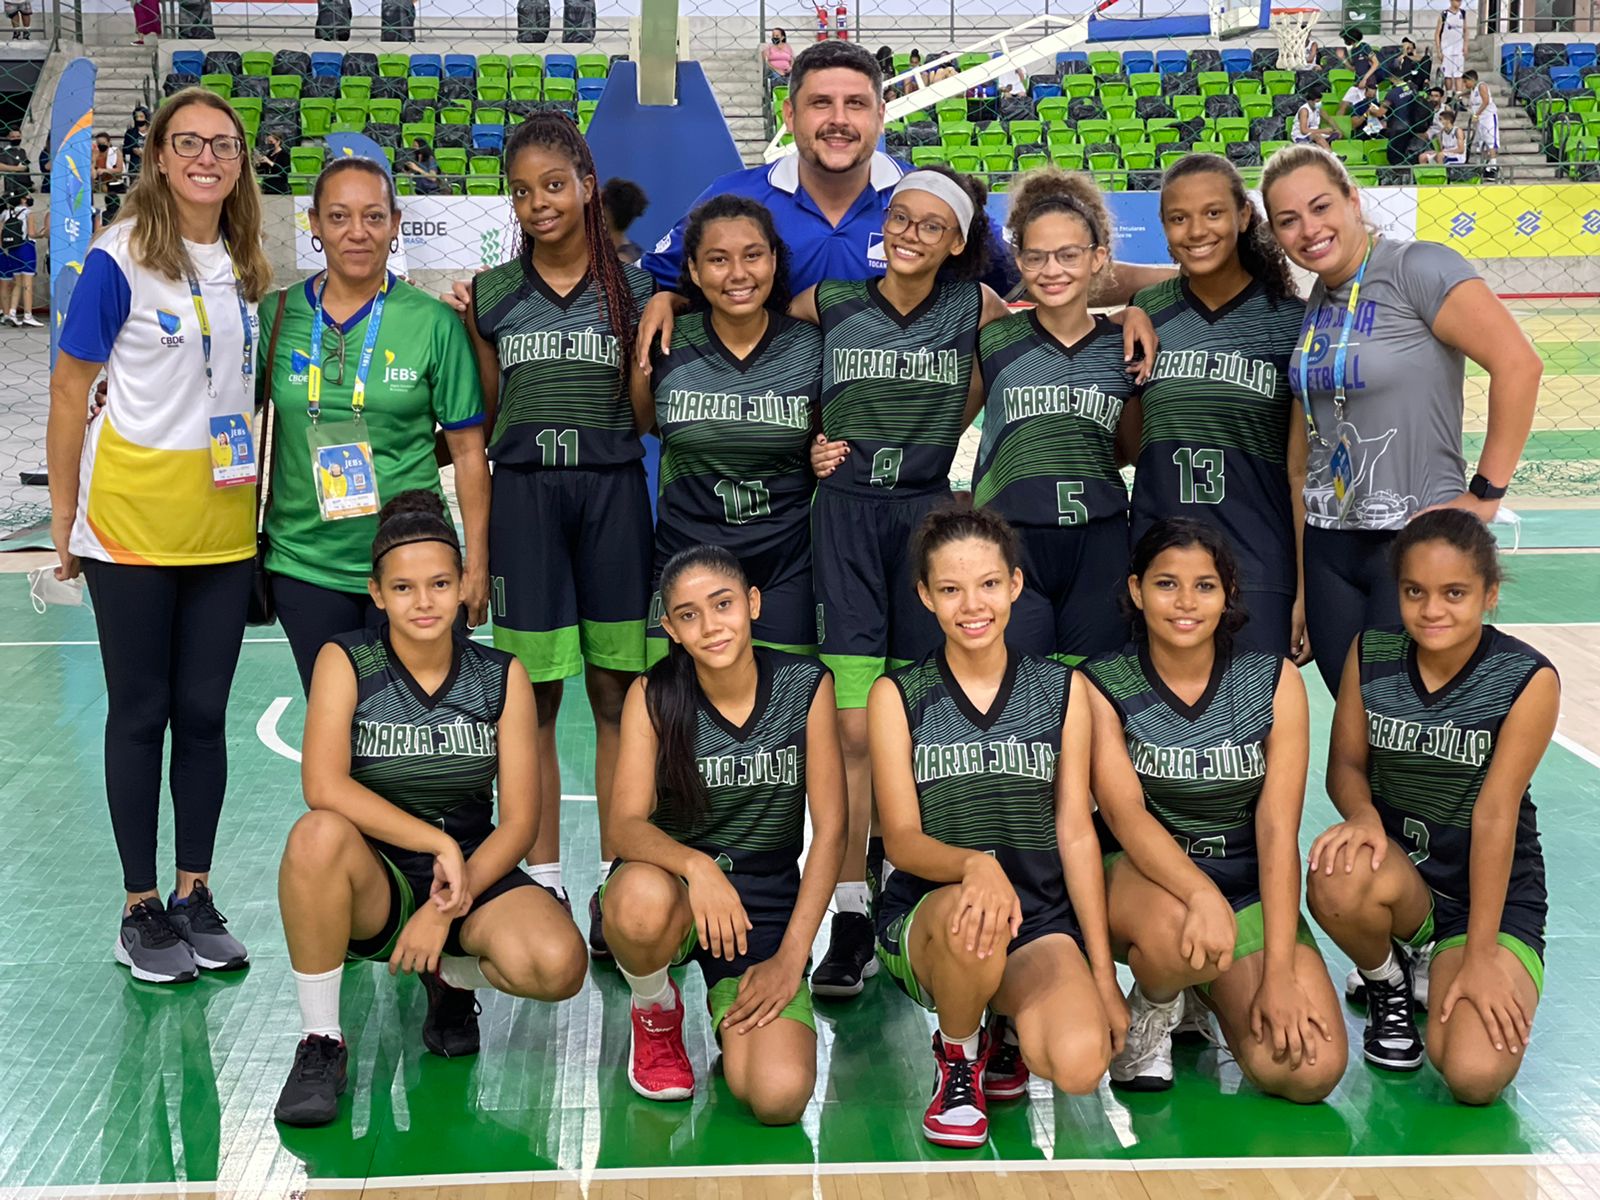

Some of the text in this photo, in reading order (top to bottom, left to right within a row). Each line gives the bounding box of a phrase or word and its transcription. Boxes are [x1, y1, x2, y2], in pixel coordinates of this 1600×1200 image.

[401, 221, 448, 236] CBDE
[160, 335, 185, 345] CBDE
[499, 331, 562, 371] MARIA
[832, 346, 958, 385] MARIA JÚLIA
[1148, 350, 1278, 399] ARIA JÚLIA
[667, 390, 810, 430] MARIA JÚLIA
[1003, 384, 1124, 433] MARIA JÚLIA
[535, 428, 579, 467] 11
[870, 447, 904, 490] 9
[1172, 447, 1226, 504] 13
[713, 479, 772, 525] 10
[1056, 481, 1089, 526] 5
[356, 720, 433, 757] MARIA
[914, 735, 1055, 783] MARIA JÚLIA
[1203, 739, 1266, 780] JÚLIA
[1365, 709, 1491, 767] ARIA JÚLIA
[695, 745, 798, 788] RIA JÚLIA
